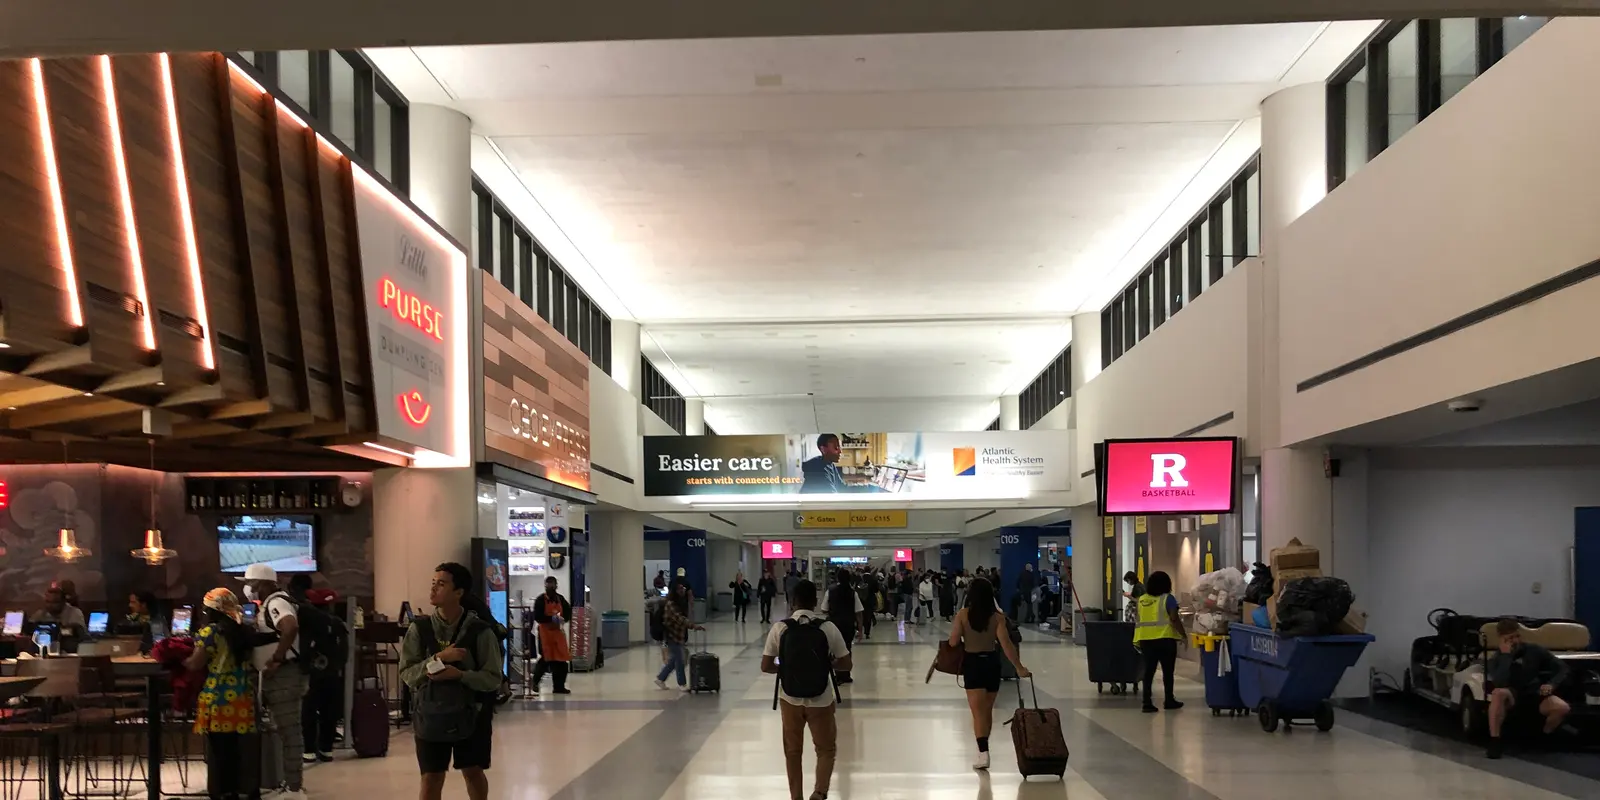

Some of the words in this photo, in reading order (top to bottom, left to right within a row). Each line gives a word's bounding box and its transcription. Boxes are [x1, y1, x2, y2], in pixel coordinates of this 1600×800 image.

[400, 234, 427, 279] Little
[981, 447, 1015, 455] Atlantic
[658, 453, 722, 471] Easier
[728, 456, 773, 471] care
[982, 456, 1011, 464] Health
[1013, 456, 1044, 465] System
[1149, 453, 1189, 488] R
[686, 477, 713, 485] starts
[713, 476, 734, 484] with
[735, 476, 780, 484] connected
[781, 476, 803, 484] care.
[1141, 489, 1196, 497] BASKETBALL
[874, 514, 891, 522] C115
[1000, 534, 1020, 544] C105
[771, 543, 783, 554] R
[896, 550, 905, 558] R
